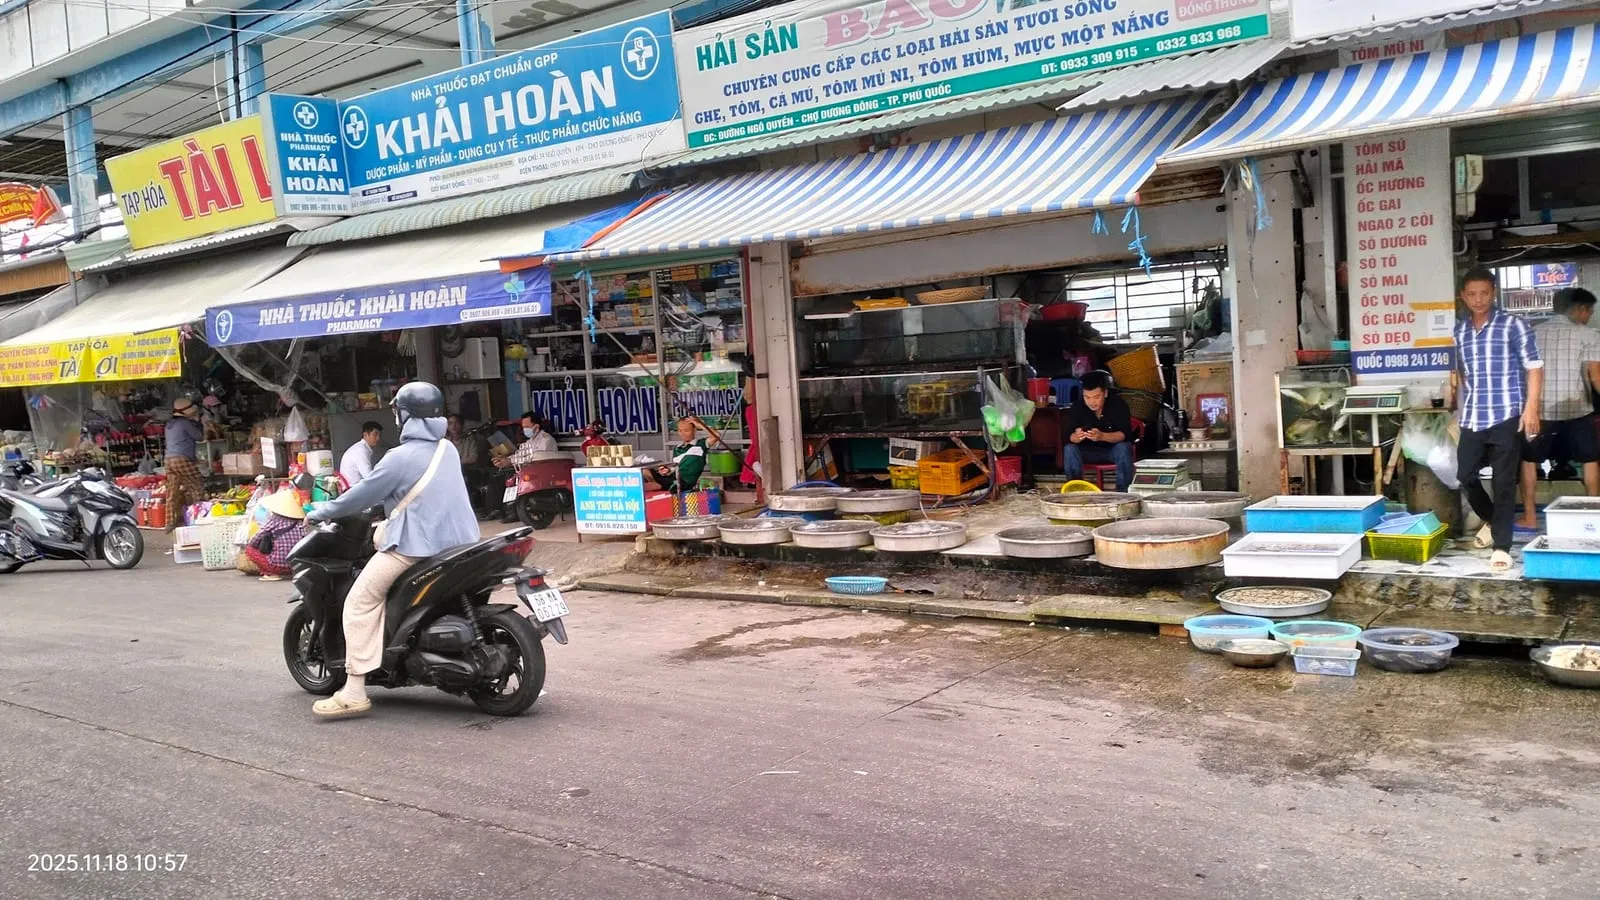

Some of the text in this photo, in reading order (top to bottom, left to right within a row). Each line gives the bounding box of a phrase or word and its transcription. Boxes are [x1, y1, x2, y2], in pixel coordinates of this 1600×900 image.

[696, 20, 799, 72] HẢI SẢN
[723, 0, 1117, 97] CHUYÊN CUNG CẤP CÁC LOẠI HẢI SẢN TƯƠI SỐNG
[1041, 25, 1242, 75] ĐT: 0933 309 915 0332 933 968
[1351, 47, 1380, 61] TÔM
[1410, 39, 1425, 52] NI
[694, 108, 727, 125] GHẸ,
[729, 100, 765, 117] TÔM,
[823, 79, 858, 97] TÔM
[890, 66, 915, 84] NI,
[919, 57, 958, 77] TÔM
[962, 45, 1009, 67] HÙM,
[1014, 36, 1055, 57] MỰC
[1062, 24, 1106, 47] MỘT
[1112, 10, 1170, 36] NẮNG
[411, 52, 558, 102] NHÀ THUỐC ĐẠT CHUẨN GPP
[375, 65, 617, 160] KHẢI HOÀN
[718, 124, 746, 141] ĐƯỜNG
[747, 121, 765, 136] NGÔ
[801, 110, 818, 125] CHỢ
[820, 103, 851, 120] DƯƠNG
[853, 97, 879, 113] ĐÔNG
[887, 94, 901, 106] TP.
[902, 88, 922, 104] PHÚ
[924, 82, 952, 99] QUỐC
[280, 131, 338, 144] NHÀ THUỐC
[366, 109, 642, 182] DƯỢC PHẨM MỸ PHẨM DỤNG CỤ Y TẾ THỰC PHẨM CHỨC NĂNG
[290, 143, 331, 152] PHARMACY
[1355, 139, 1407, 157] TÔM SÚ
[287, 153, 338, 172] KHẢI
[1355, 157, 1405, 176] HẢI MÃ
[158, 137, 244, 221] TÀI
[286, 175, 345, 192] HOÀN
[1356, 176, 1425, 194] ỐC HƯƠNG
[121, 182, 168, 218] TẠP HÓA
[1357, 198, 1402, 213] ỐC GAI
[1357, 217, 1394, 232] NGAO
[1398, 216, 1407, 229] 2
[1359, 234, 1427, 251] SÒ DƯƠNG
[1360, 255, 1377, 270] SÒ
[1360, 274, 1409, 289] SÒ MAI
[1536, 271, 1569, 285] Tiger
[258, 283, 468, 327] NHÀ THUỐC KHẢI HOÀN
[1361, 292, 1405, 308] ỐC VOI
[326, 317, 384, 333] PHARMACY
[1362, 311, 1416, 327] ỐC GIÁC
[1362, 330, 1411, 346] SÒ DẸO
[67, 343, 85, 354] TẠP
[1357, 351, 1449, 369] QUỐC 0988 241 249
[532, 375, 658, 435] KHẢI HOÀN
[671, 388, 743, 419] PHARMACY
